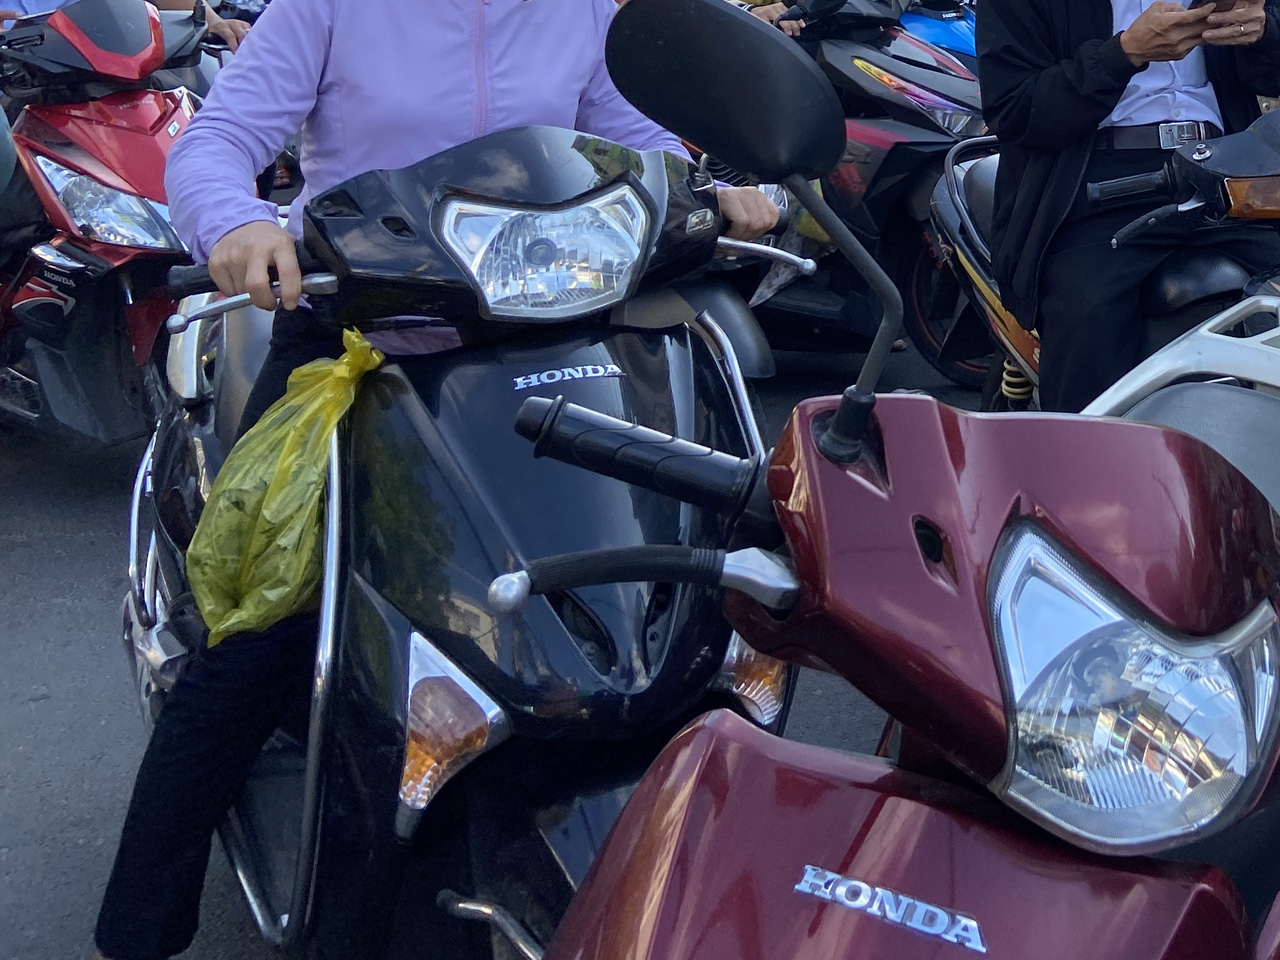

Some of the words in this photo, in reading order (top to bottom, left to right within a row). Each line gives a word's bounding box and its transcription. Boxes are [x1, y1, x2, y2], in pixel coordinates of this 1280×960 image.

[43, 269, 77, 288] HONDA
[513, 363, 627, 391] HONDA
[793, 863, 988, 954] HONDA
